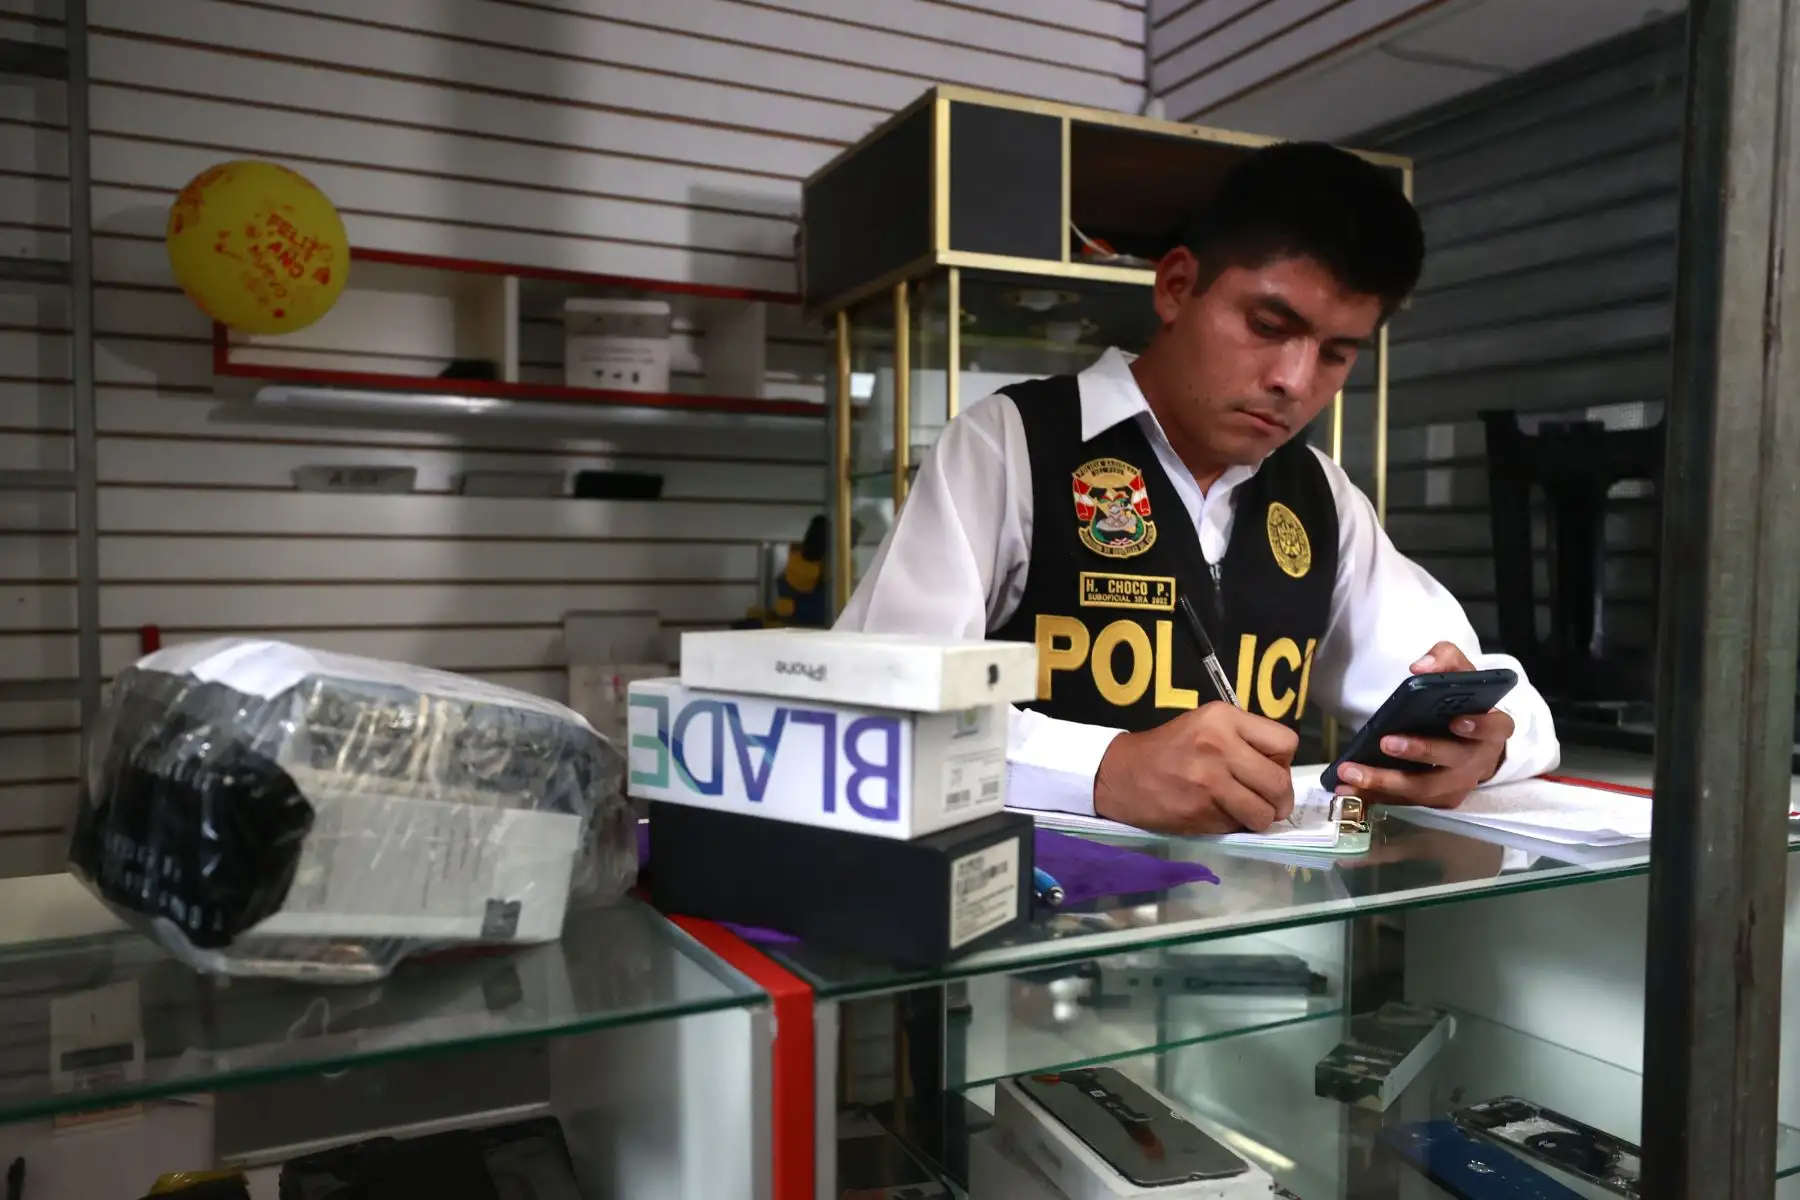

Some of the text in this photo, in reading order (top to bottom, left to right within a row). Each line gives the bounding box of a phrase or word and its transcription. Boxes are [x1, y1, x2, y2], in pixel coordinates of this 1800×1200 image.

[1086, 578, 1169, 597] H. CHOCO P.
[775, 659, 827, 681] iPhone
[1035, 614, 1317, 720] POLICI
[629, 692, 901, 822] BLADE
